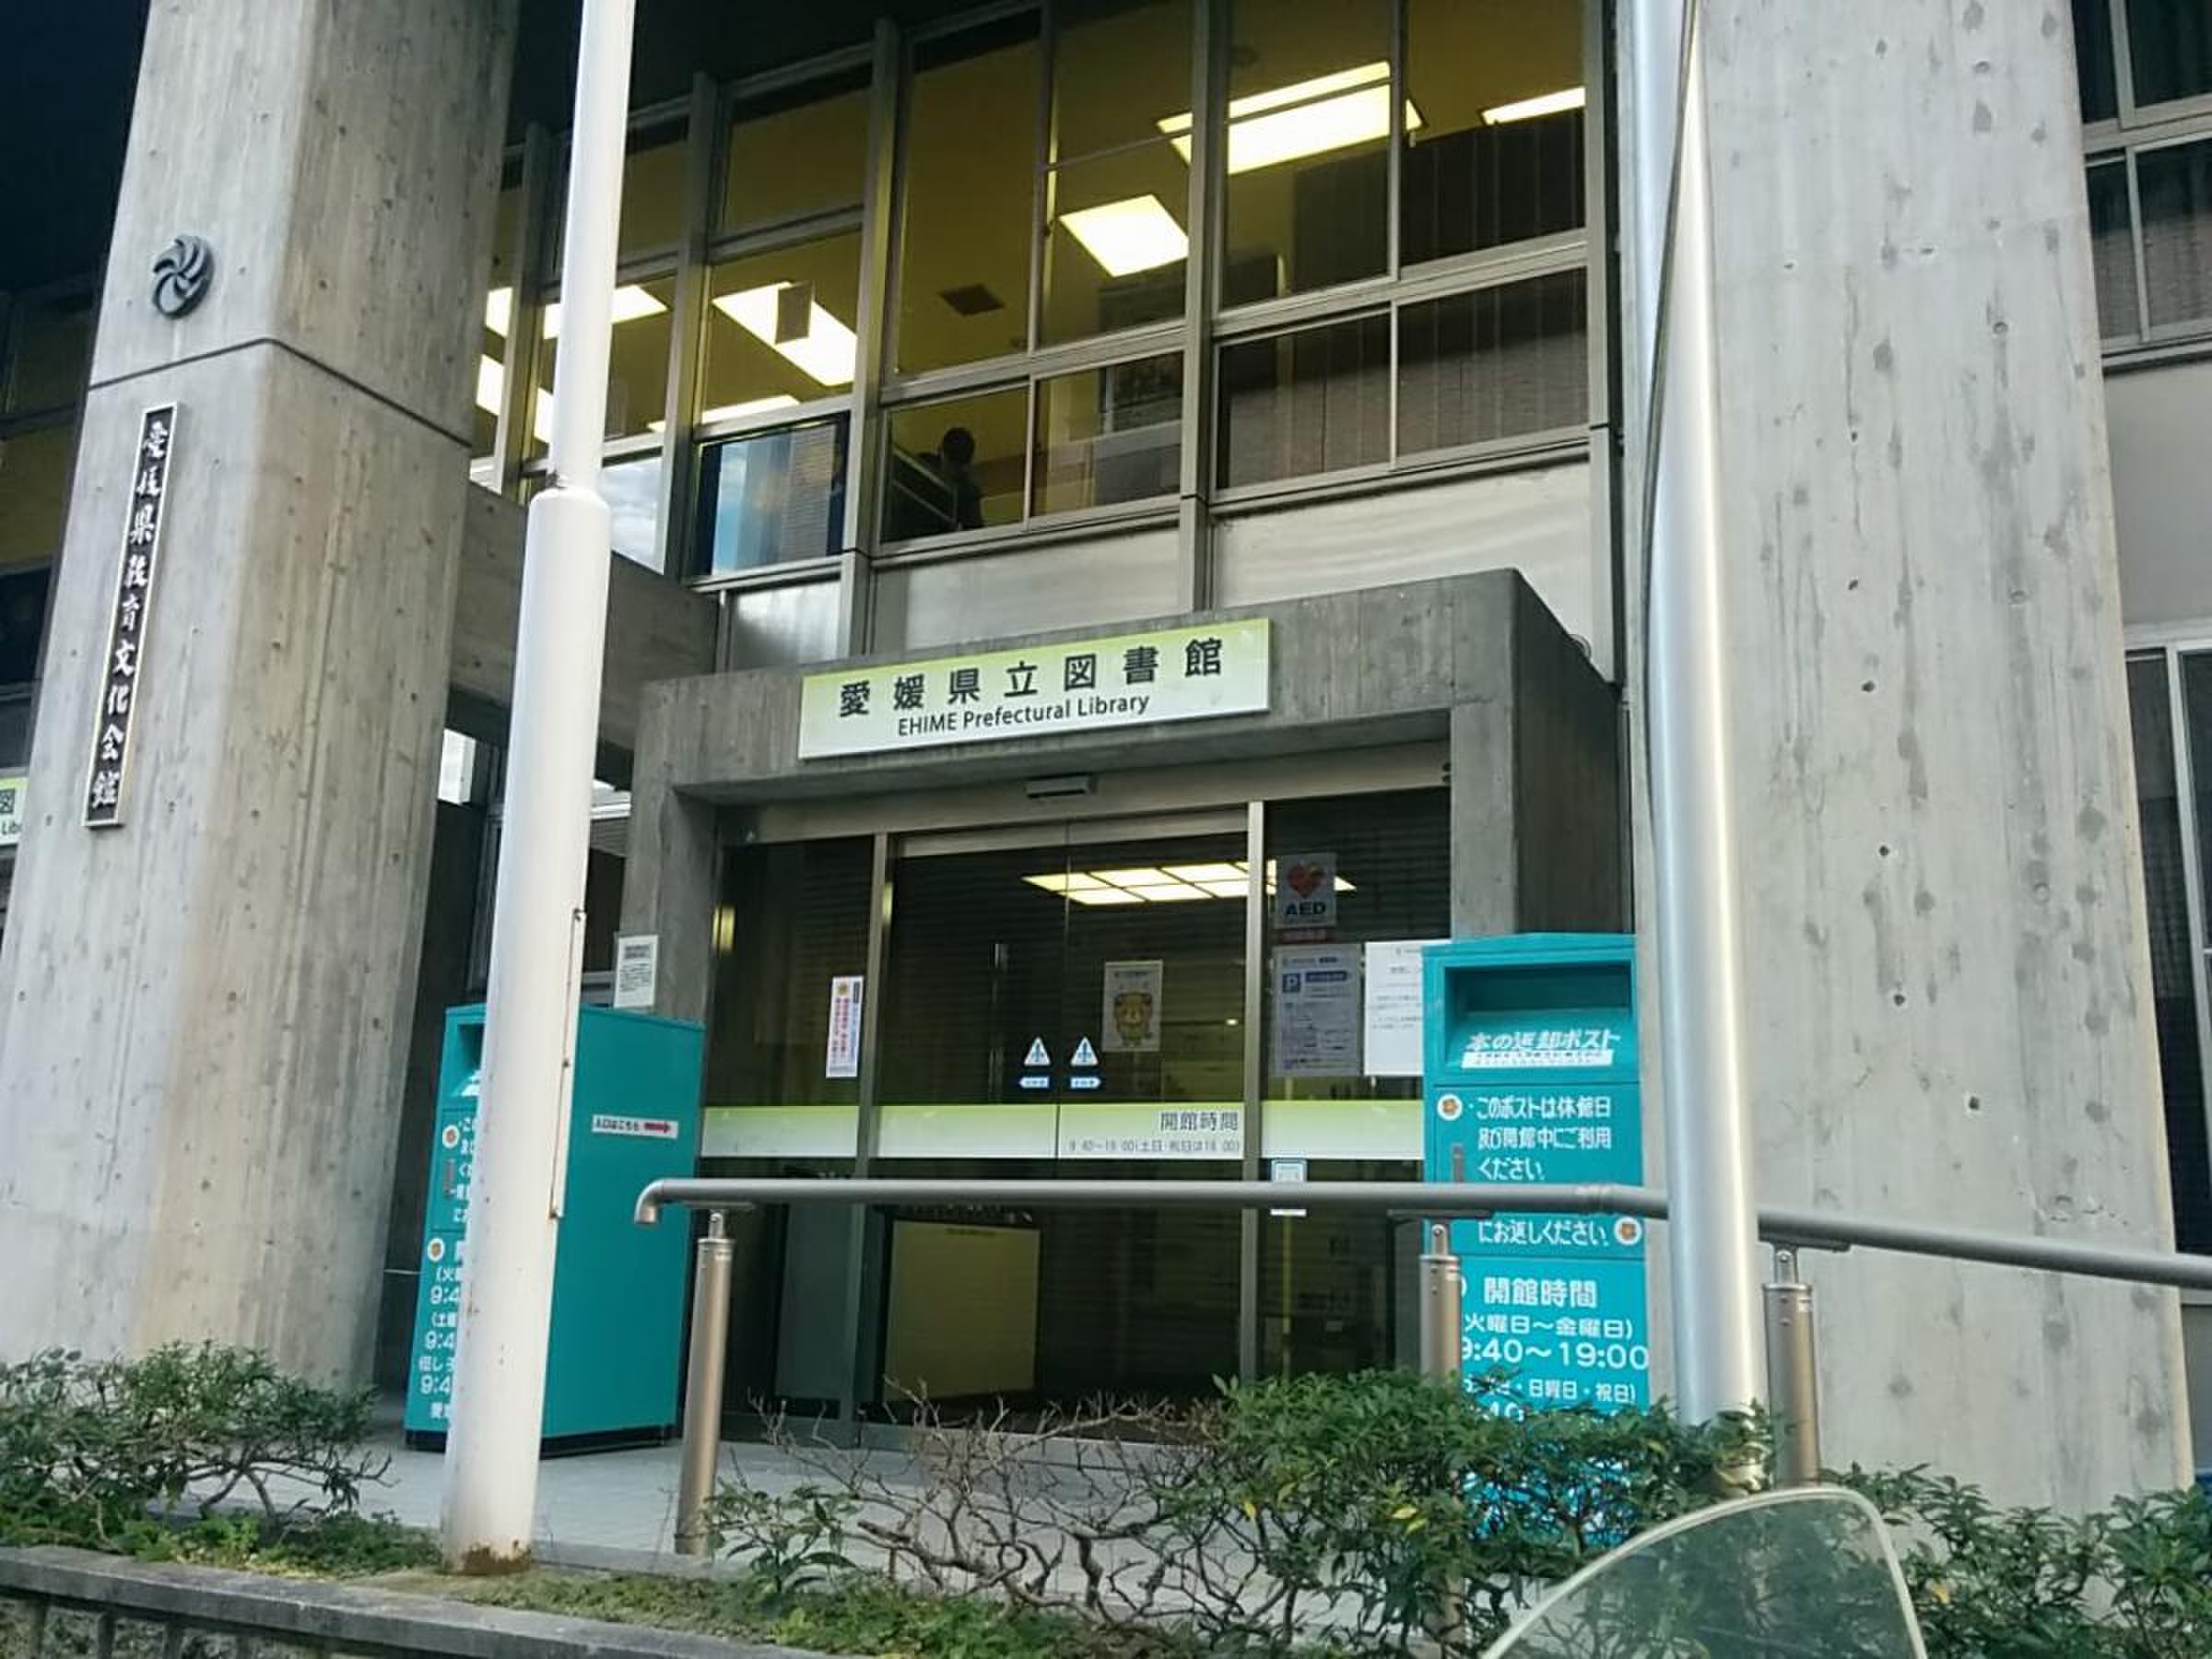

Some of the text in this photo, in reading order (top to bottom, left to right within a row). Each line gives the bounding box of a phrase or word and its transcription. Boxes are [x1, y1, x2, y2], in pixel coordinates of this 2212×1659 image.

[840, 638, 1224, 718] 愛媛県立図書館
[898, 693, 1151, 737] EHIME Prefectural Library
[1286, 900, 1327, 916] AED
[1159, 1112, 1239, 1132] 開館時間
[1484, 1277, 1597, 1309] 開館時間
